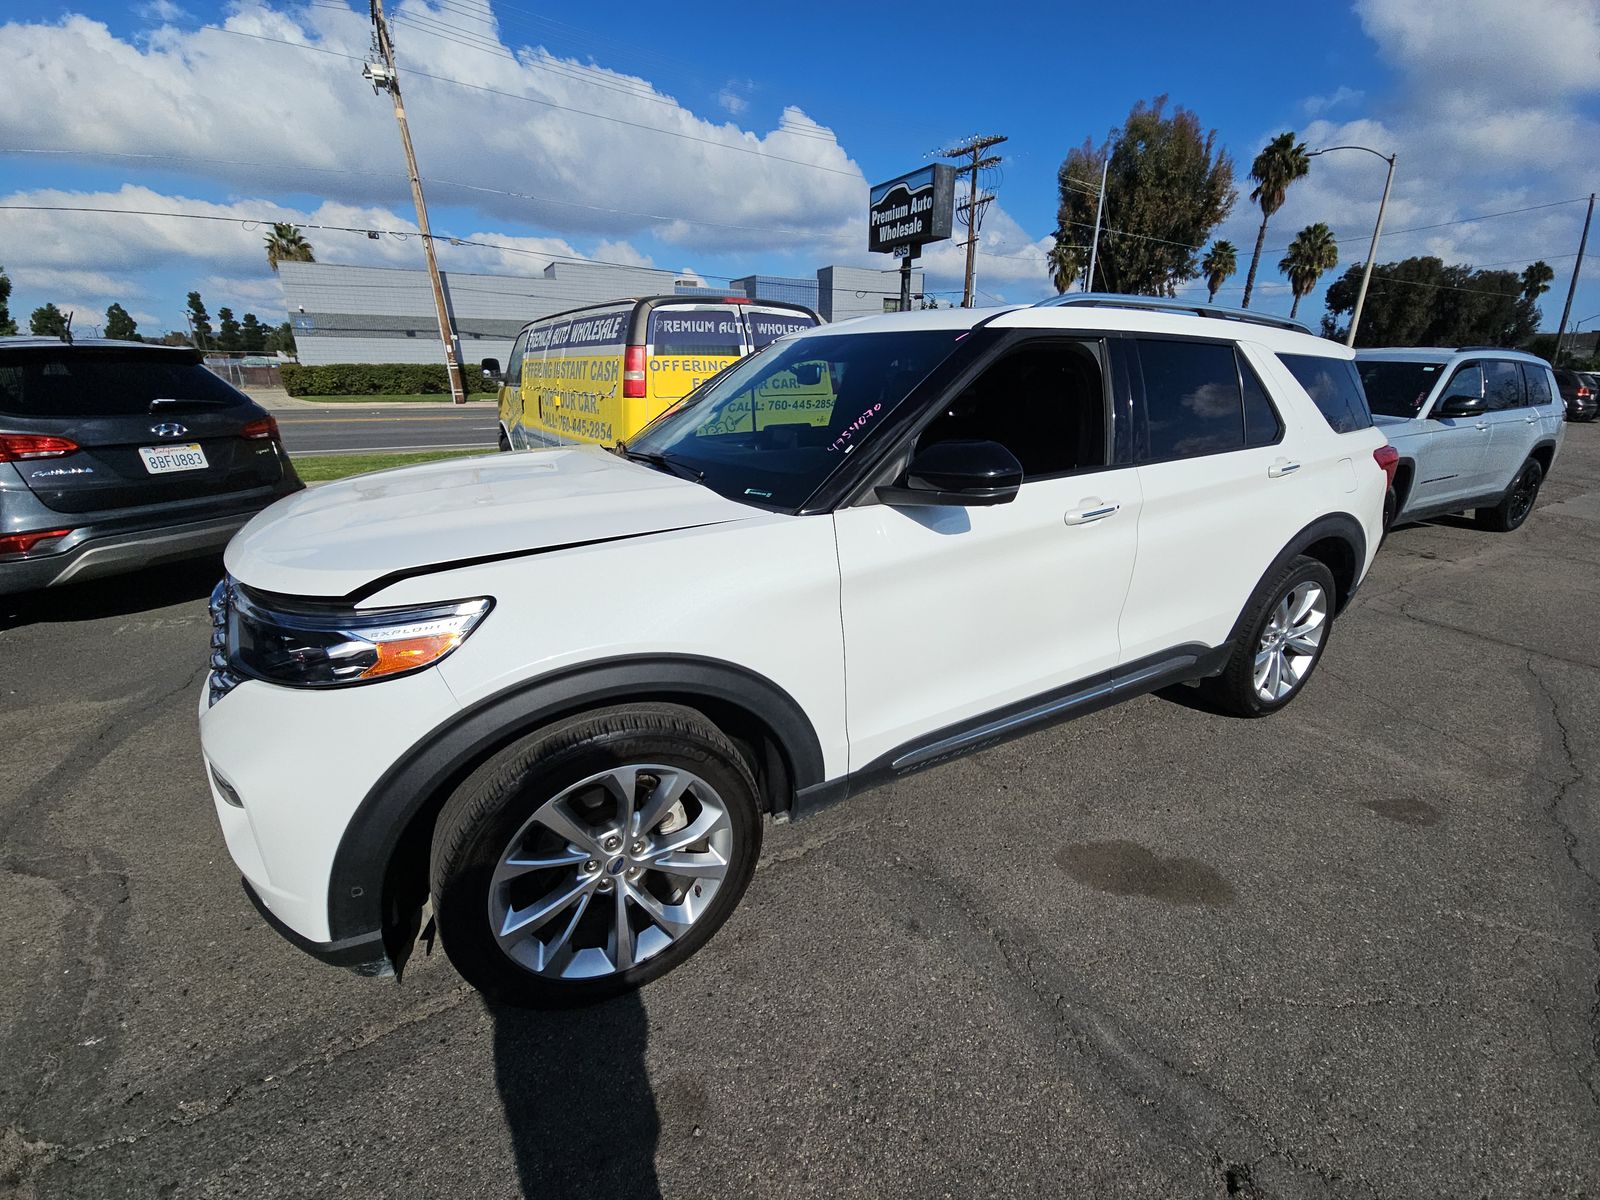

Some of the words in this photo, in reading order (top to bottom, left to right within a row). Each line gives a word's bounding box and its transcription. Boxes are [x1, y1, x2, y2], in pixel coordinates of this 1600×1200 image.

[871, 204, 909, 226] Premium
[910, 195, 933, 214] Auto
[879, 217, 923, 242] Wholesale
[570, 317, 622, 343] WHOLESALE
[656, 320, 715, 333] PREMIUM
[719, 322, 753, 334] AUTO
[590, 360, 619, 382] CASH
[728, 401, 765, 413] CALL:
[558, 414, 612, 442] 760-445-2854
[148, 452, 203, 469] 8BFU883
